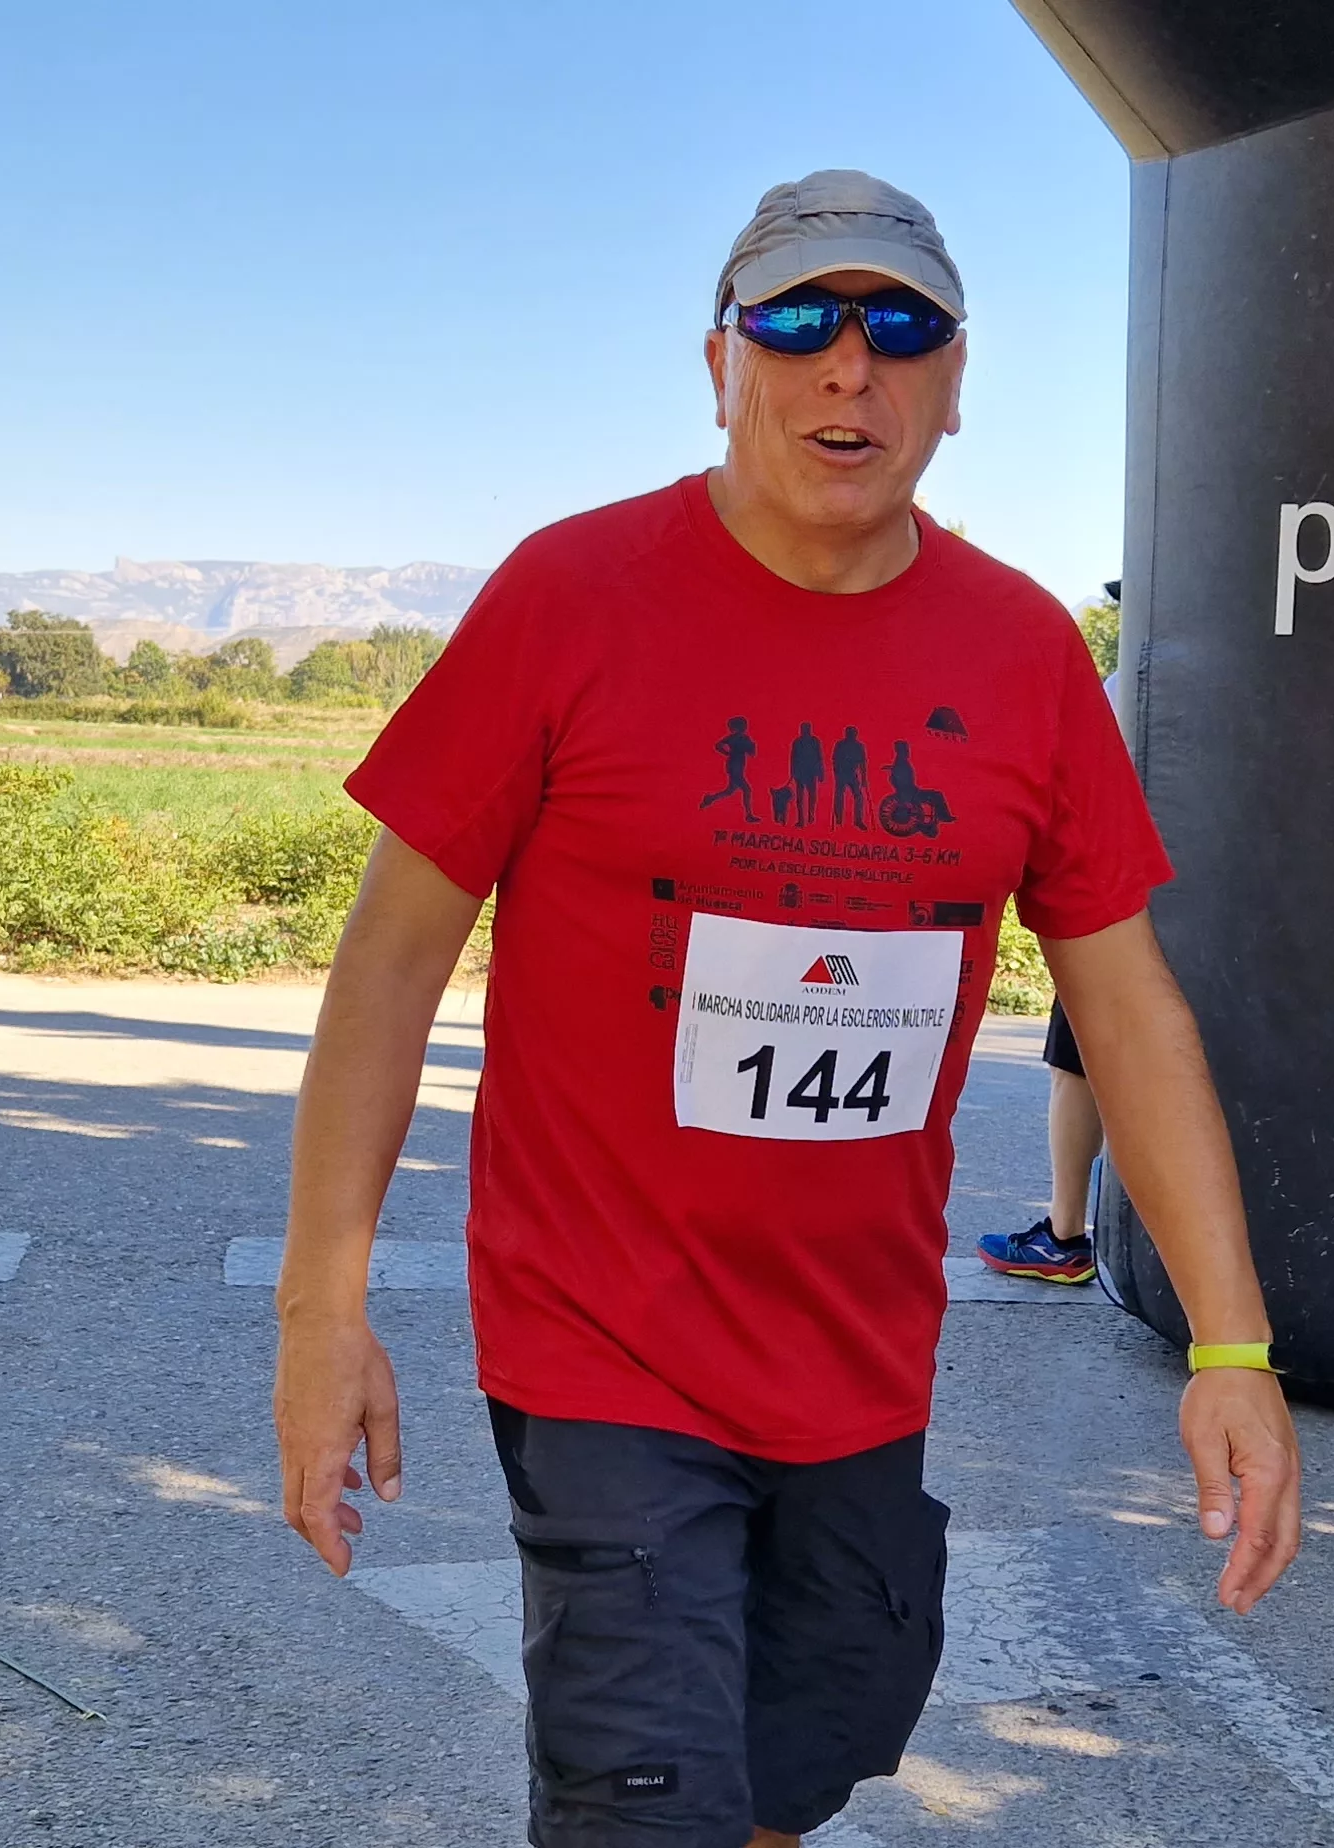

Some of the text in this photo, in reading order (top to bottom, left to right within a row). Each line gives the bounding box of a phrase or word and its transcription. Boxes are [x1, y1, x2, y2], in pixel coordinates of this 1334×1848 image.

[730, 856, 757, 870] POR
[758, 861, 776, 874] LA
[731, 831, 805, 854] MARCHA
[808, 840, 900, 863] SOLIDARIA
[936, 848, 962, 867] KM
[801, 986, 847, 996] AODEM
[698, 992, 743, 1019] MARCHA
[745, 999, 800, 1025] SOLIDARIA
[802, 1005, 825, 1026] POR
[826, 1006, 839, 1027] LA
[841, 1007, 900, 1029] ESCLEROSIS
[900, 1003, 945, 1028] MÚLTIPLE
[737, 1044, 892, 1124] 144
